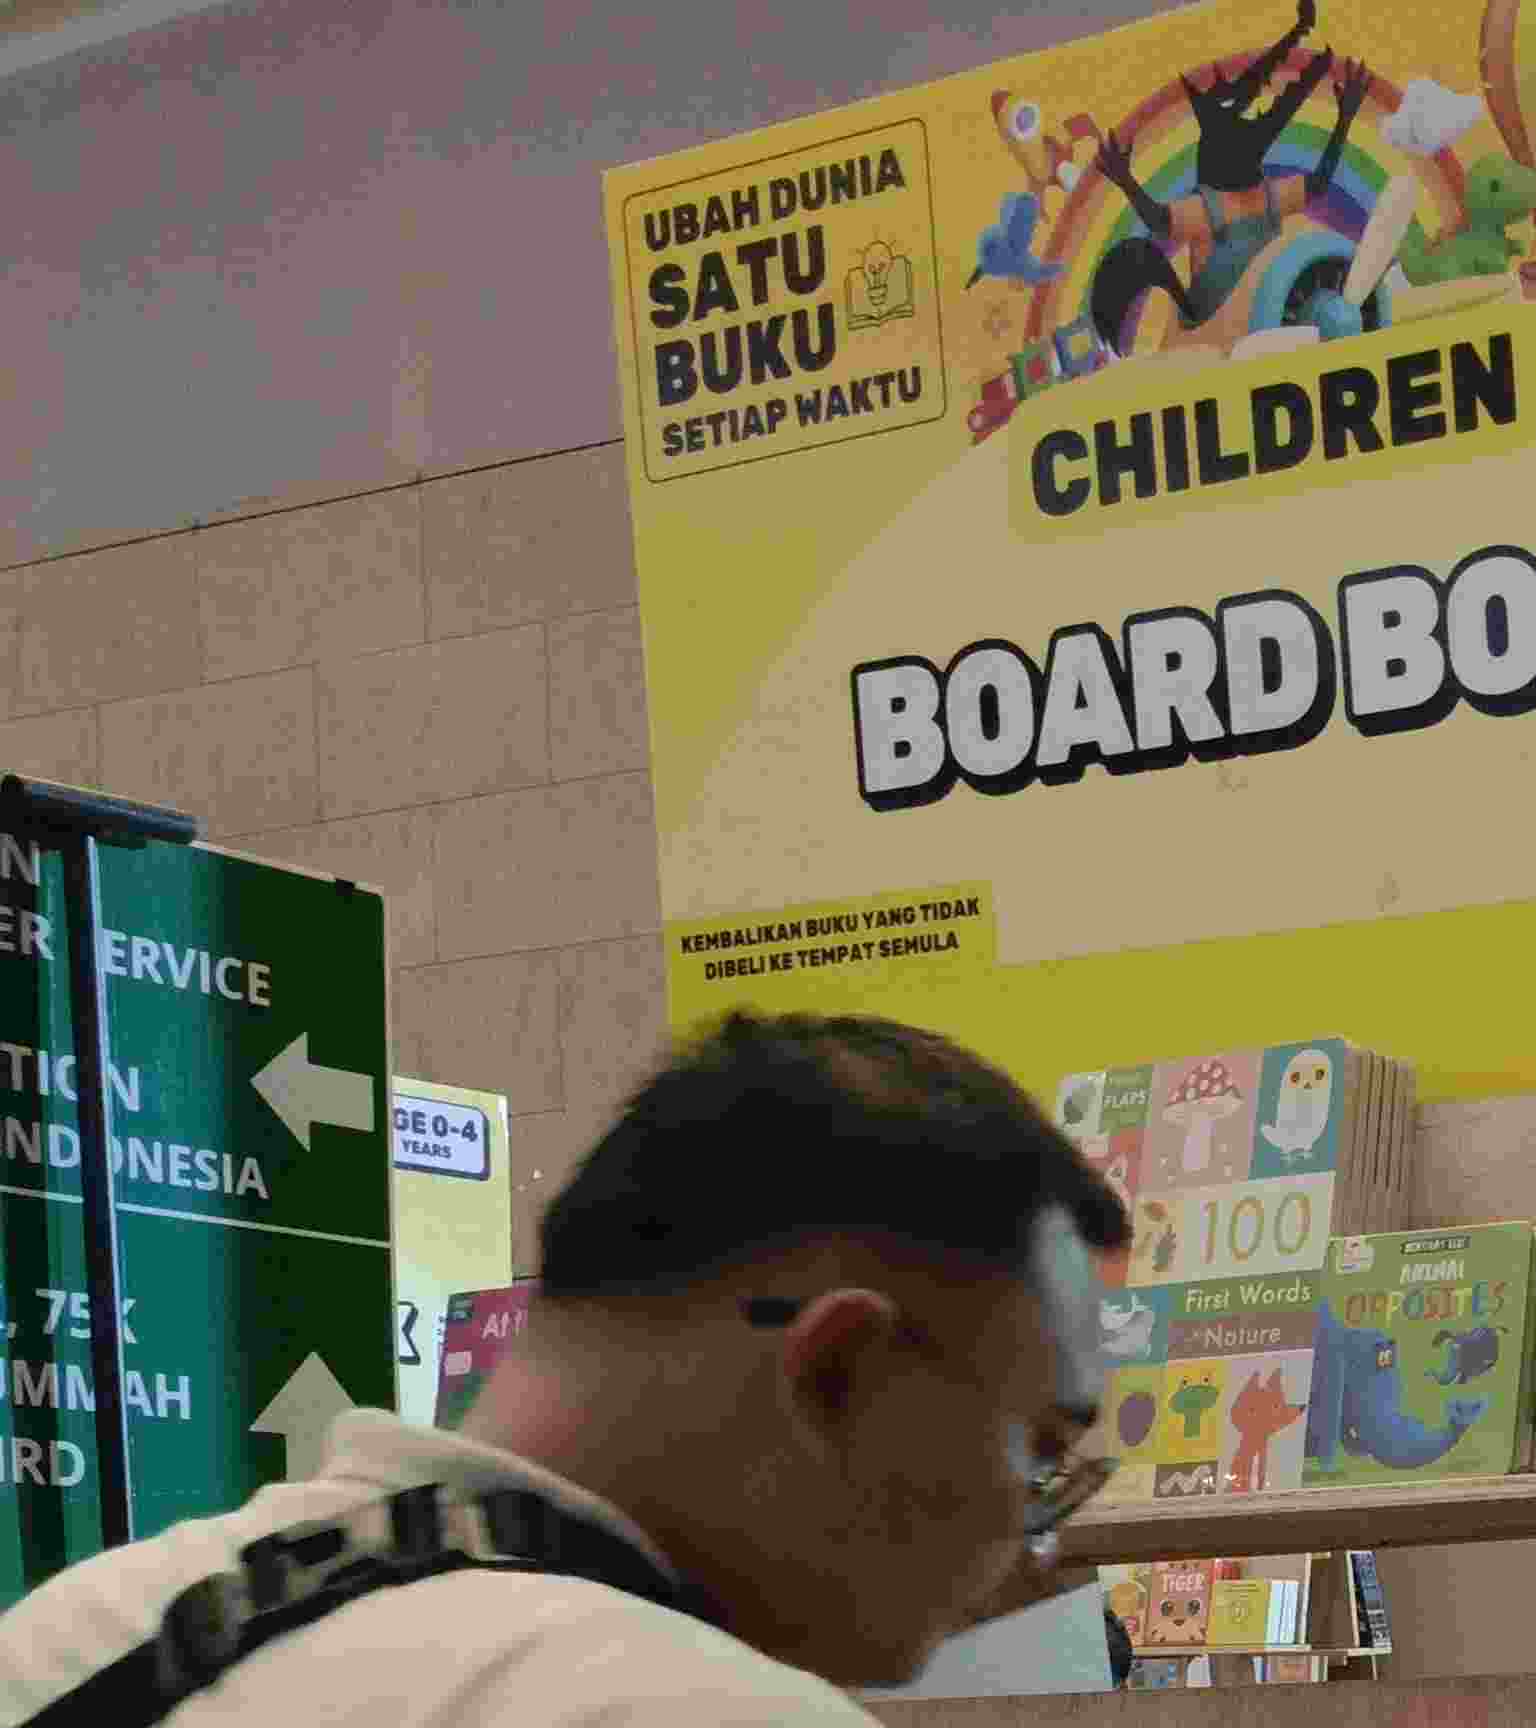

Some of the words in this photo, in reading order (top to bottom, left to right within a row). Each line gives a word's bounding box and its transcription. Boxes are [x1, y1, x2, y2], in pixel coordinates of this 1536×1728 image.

[643, 178, 760, 253] UBAH
[768, 147, 905, 218] DUNIA
[647, 226, 827, 330] SATU
[653, 302, 838, 407] BUKU
[661, 397, 787, 459] SETIAP
[793, 365, 923, 428] WAKTU
[1030, 332, 1518, 516] CHILDREN
[851, 586, 1336, 814] BOARD
[680, 919, 802, 955] KEMBALIKAN
[805, 913, 859, 939] BUKU
[861, 904, 917, 931] YANG
[919, 896, 981, 922] TIDAK
[704, 954, 766, 981] DIBELI
[769, 950, 793, 974] KE
[796, 941, 875, 970] TEMPAT
[879, 930, 960, 960] SEMULA
[102, 926, 272, 1008] ERVICE
[393, 1107, 427, 1136] GE
[431, 1114, 479, 1143] 0-4
[401, 1138, 452, 1160] YEARS
[1199, 1188, 1313, 1265] 100
[1184, 1288, 1231, 1314] First
[1239, 1280, 1313, 1308] Words
[1203, 1322, 1282, 1349] Nature
[1160, 1572, 1206, 1594] TIGER
